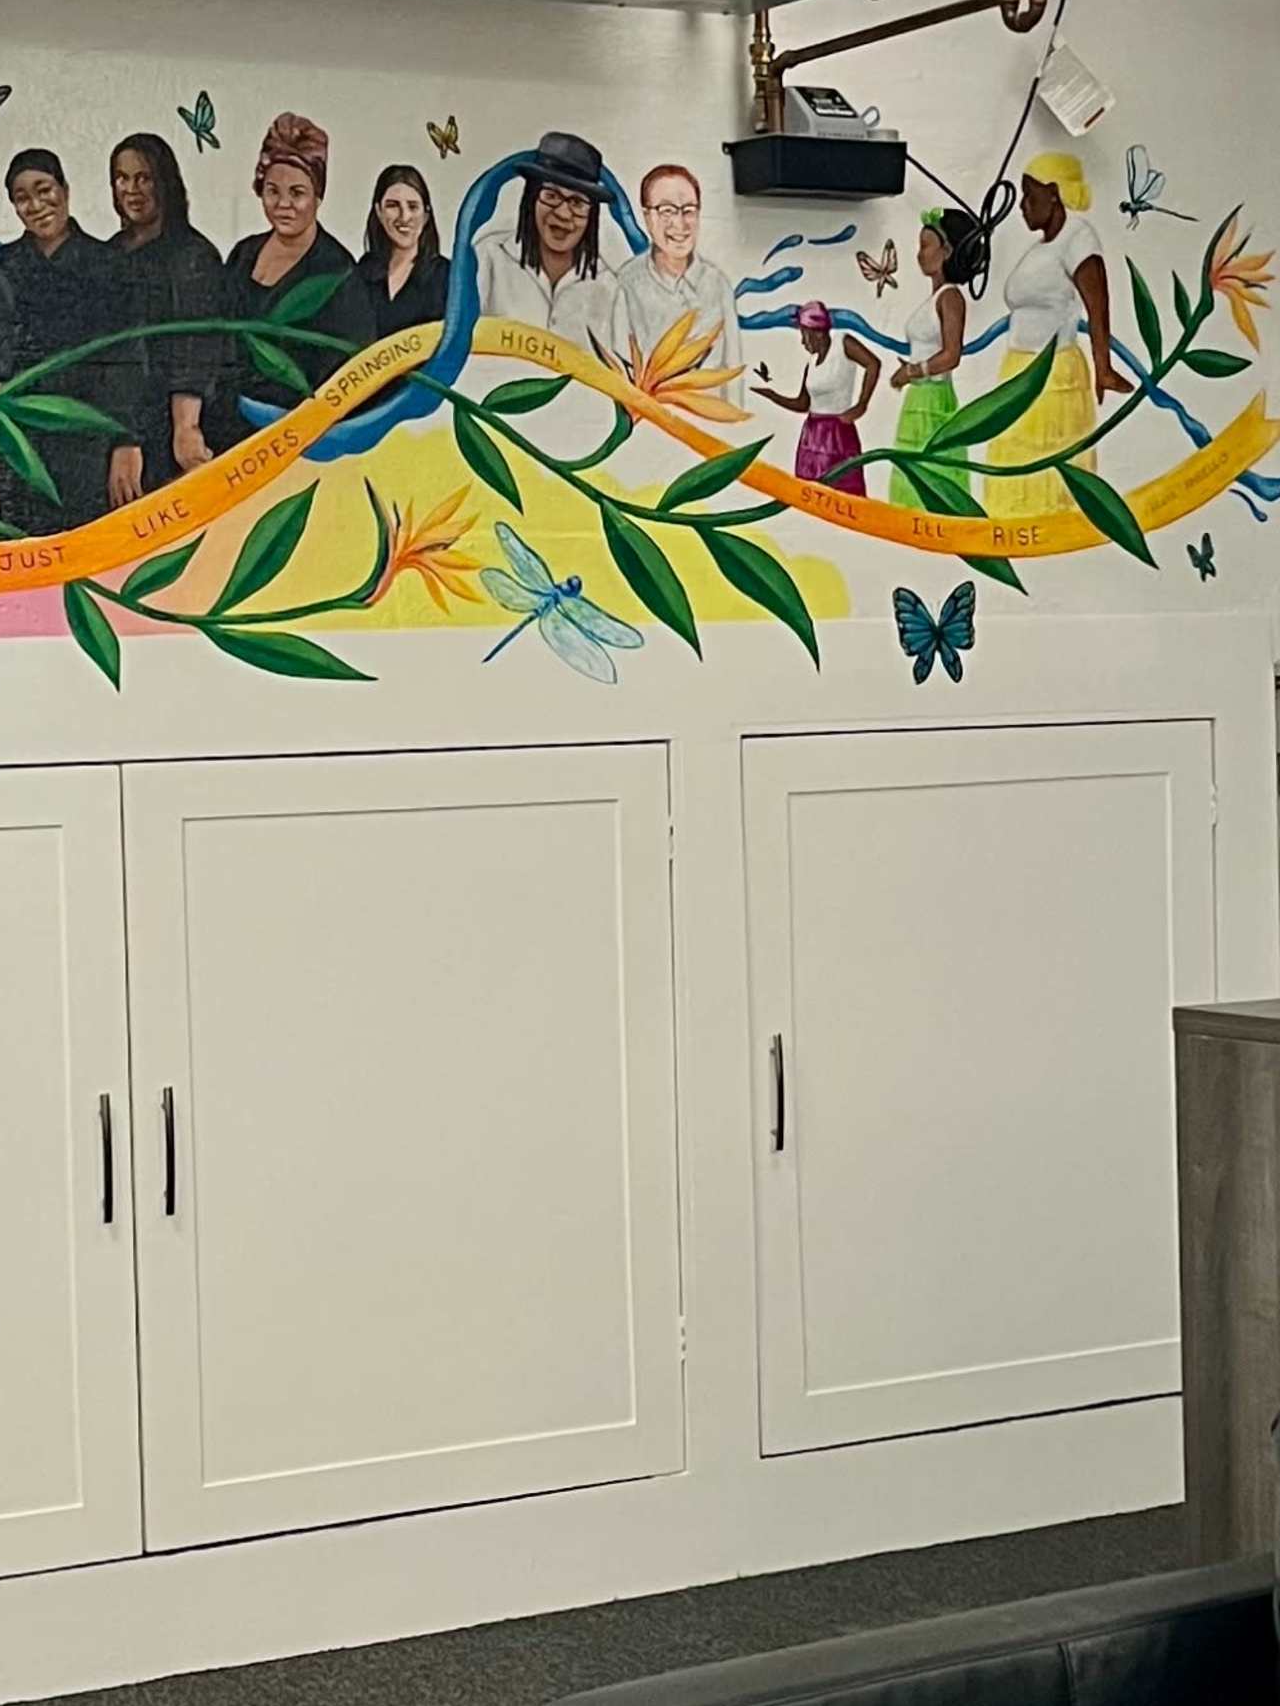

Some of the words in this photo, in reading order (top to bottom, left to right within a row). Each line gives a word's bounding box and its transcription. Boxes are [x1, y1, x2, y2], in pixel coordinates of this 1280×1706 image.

[0, 546, 68, 573] JUST
[131, 497, 191, 540] LIKE
[224, 428, 300, 490] HOPES
[323, 332, 423, 408] SPRINGING
[800, 487, 858, 521] STILL
[992, 525, 1041, 547] RISE
